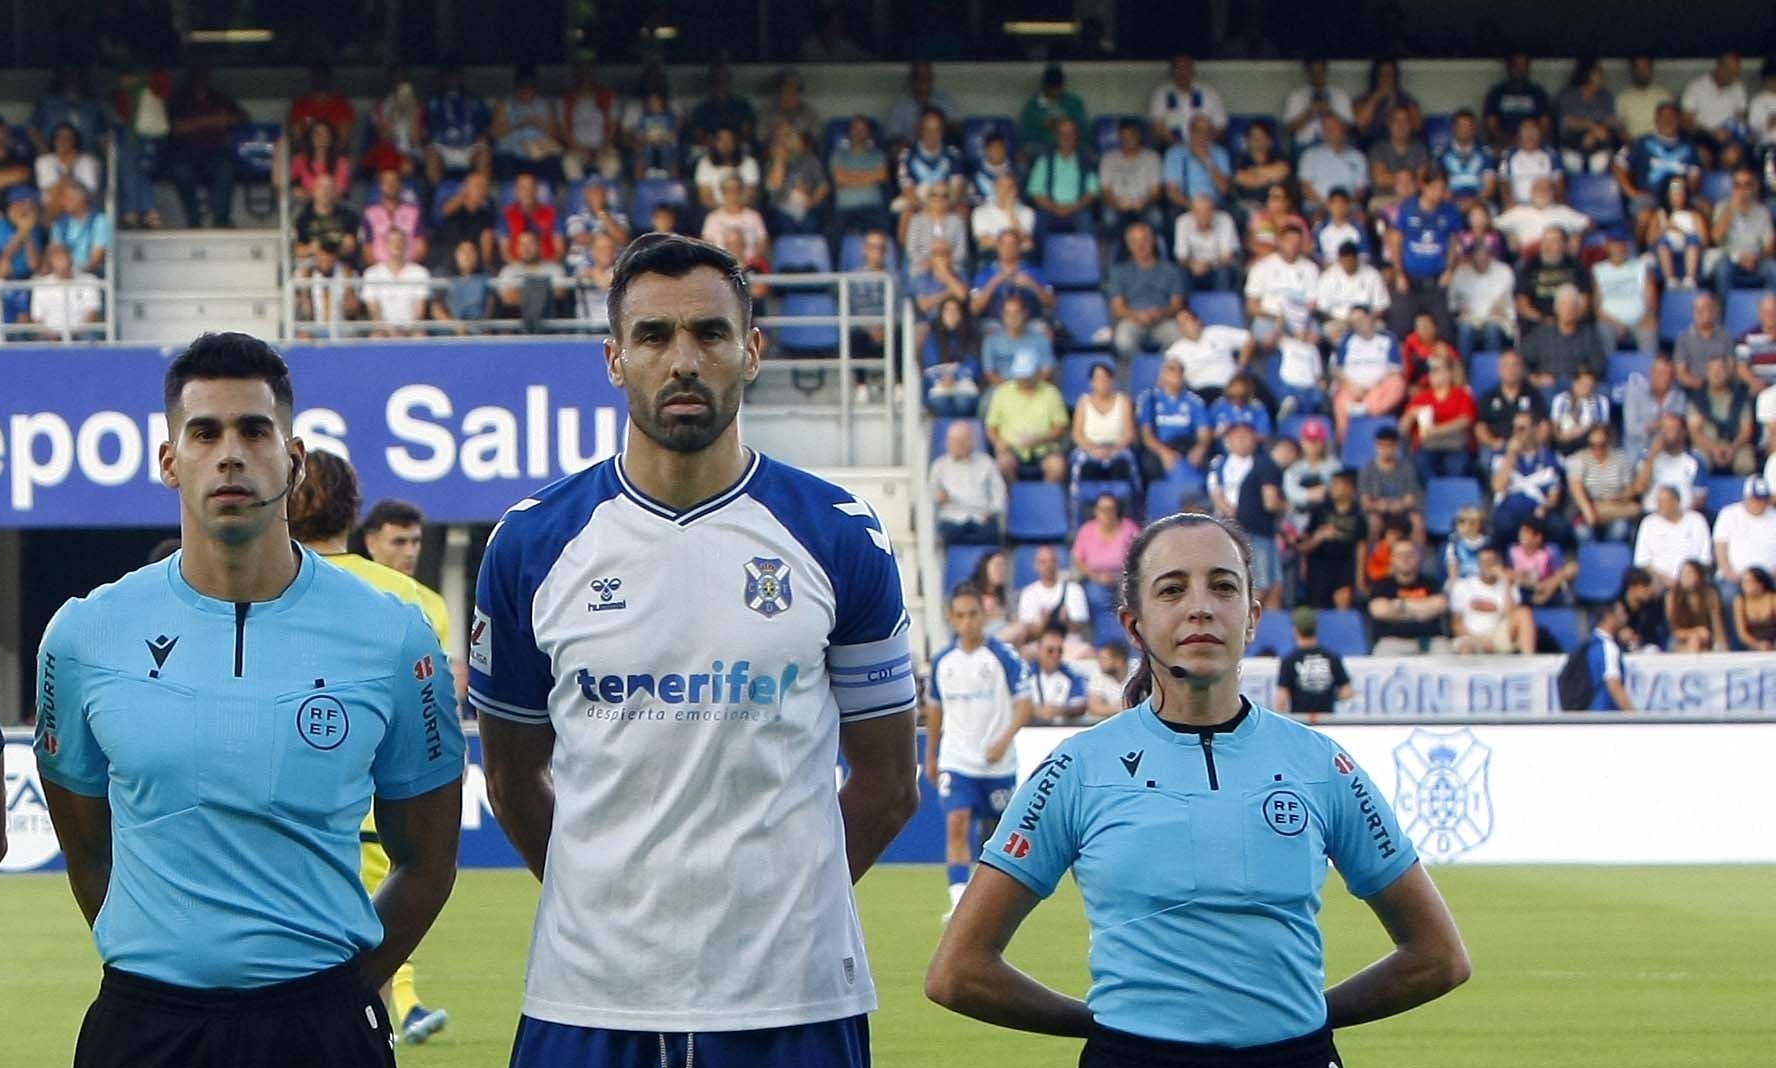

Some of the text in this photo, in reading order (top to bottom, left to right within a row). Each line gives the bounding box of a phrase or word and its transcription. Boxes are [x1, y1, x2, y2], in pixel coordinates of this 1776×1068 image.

[420, 682, 442, 761] WÜRTH
[586, 705, 772, 722] despierta emociones
[1019, 753, 1073, 832] WÜRTH
[1350, 777, 1396, 859] WÜRTH
